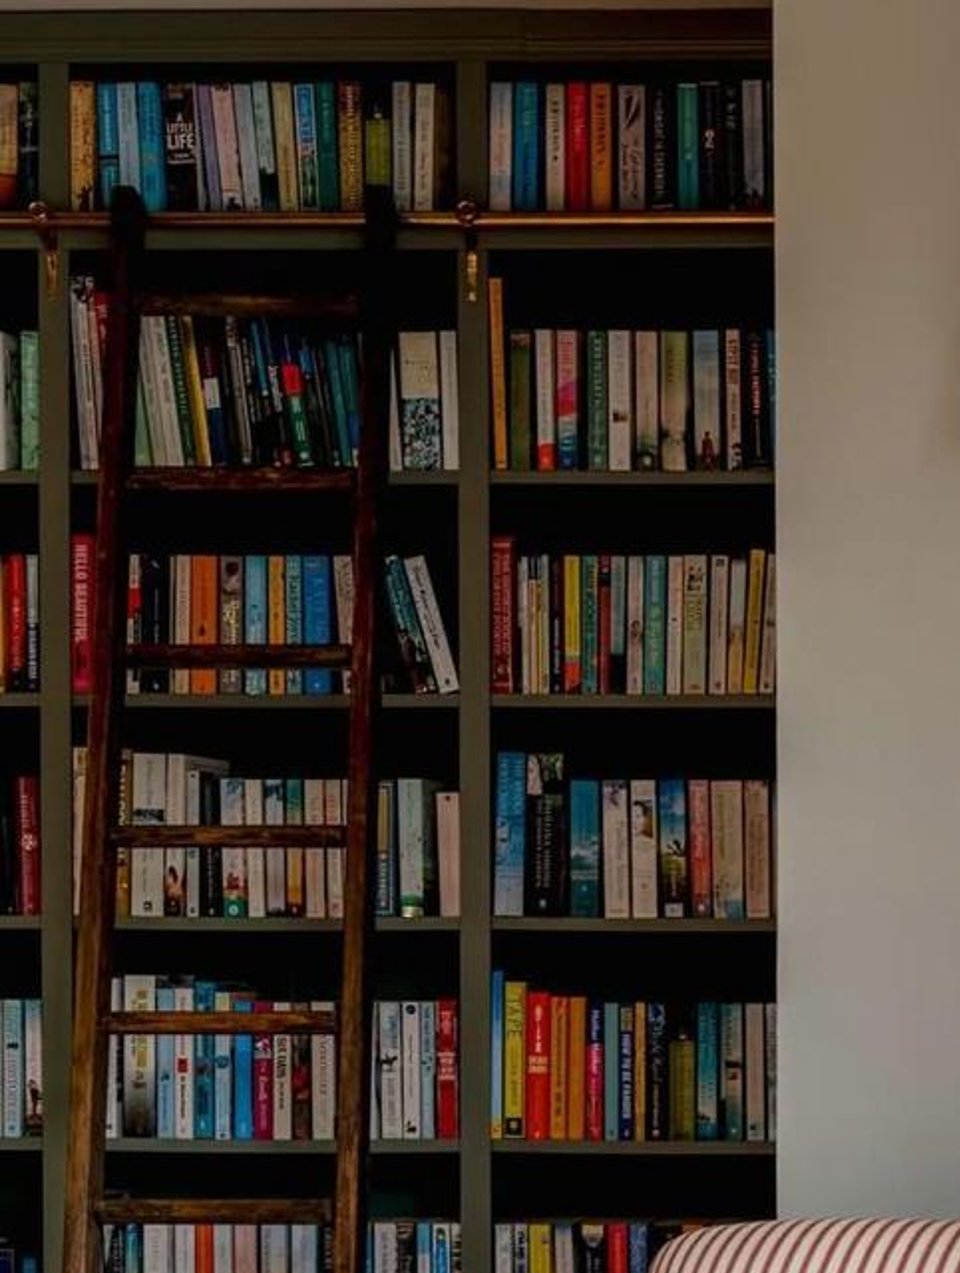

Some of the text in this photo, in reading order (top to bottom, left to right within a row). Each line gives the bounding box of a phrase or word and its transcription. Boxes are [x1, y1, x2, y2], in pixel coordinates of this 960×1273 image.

[167, 134, 195, 150] LIFE
[74, 544, 88, 644] HELLO BEAUTIFUL
[622, 1034, 632, 1054] HOW
